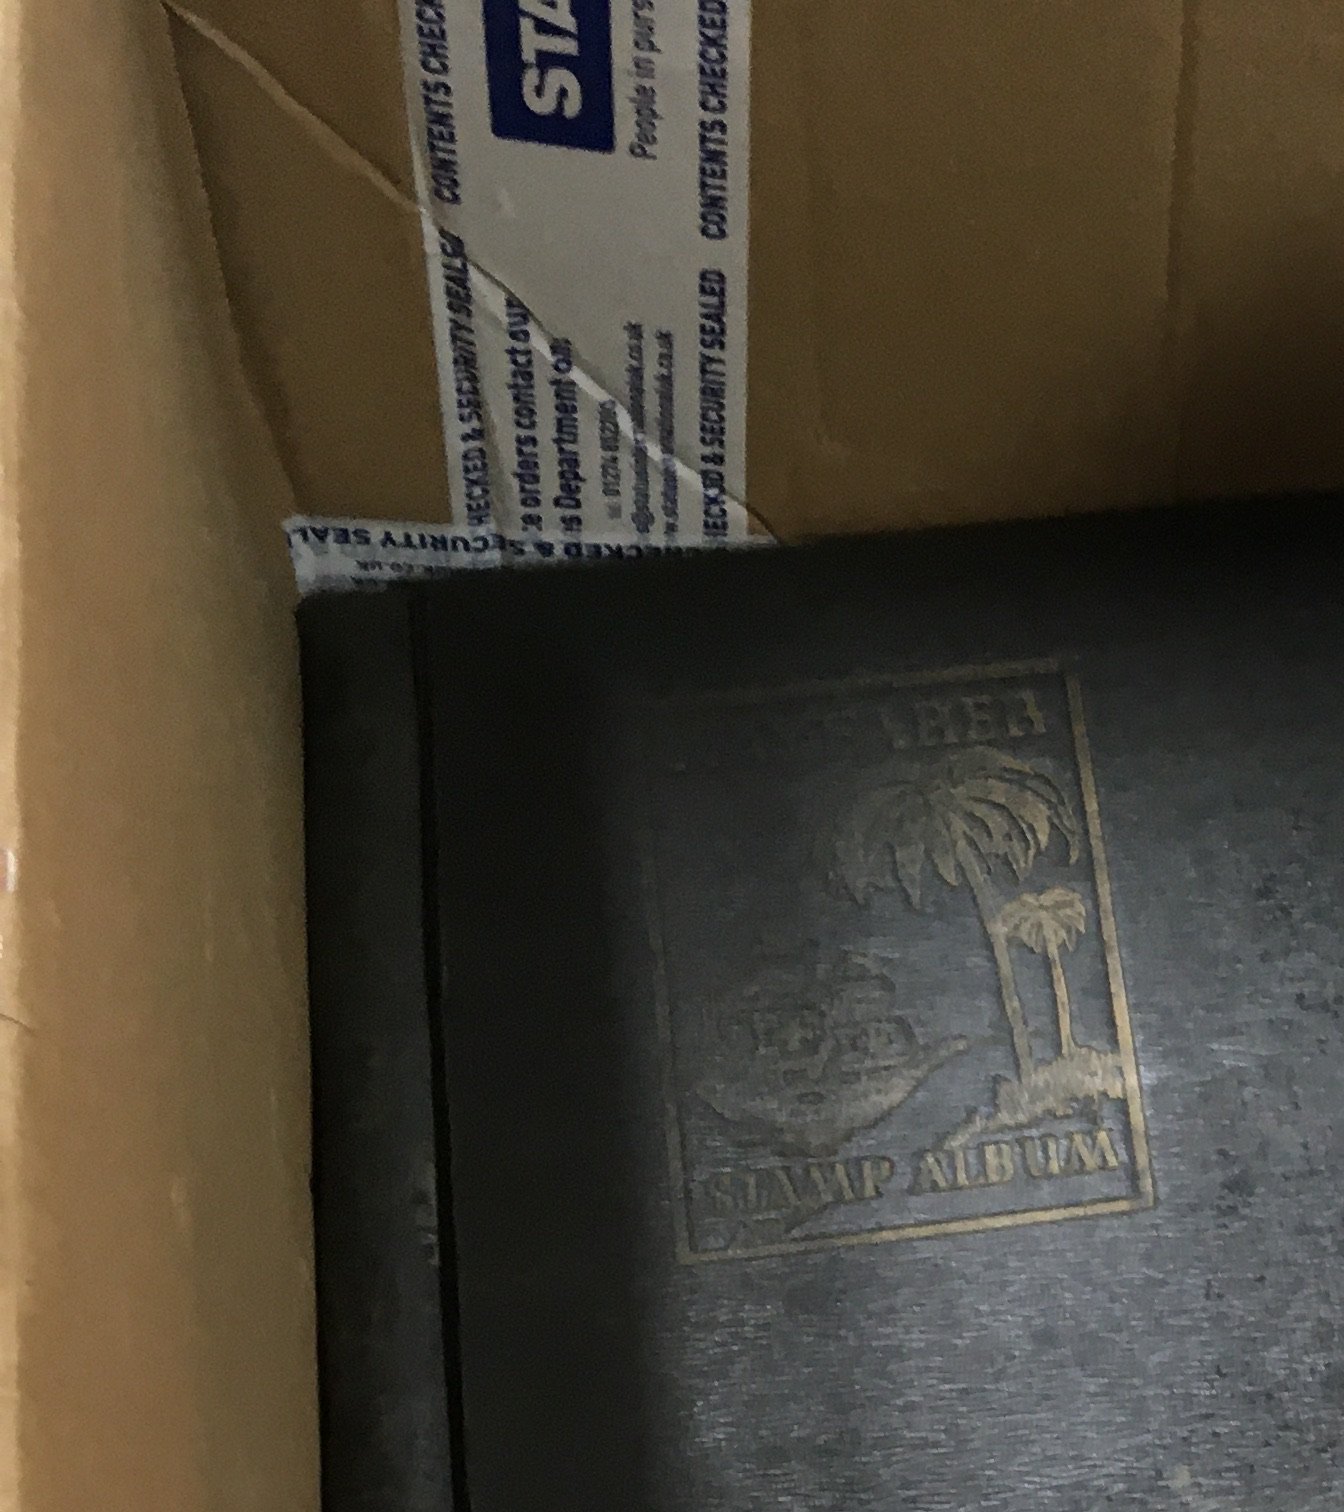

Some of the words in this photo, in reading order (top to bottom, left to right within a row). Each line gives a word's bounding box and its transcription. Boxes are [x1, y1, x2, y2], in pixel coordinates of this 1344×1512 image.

[698, 0, 728, 115] CHECKED
[421, 78, 461, 205] CONTENTS
[626, 85, 664, 160] People
[698, 117, 729, 241] CONTENTS
[698, 267, 728, 351] SEALED
[448, 317, 482, 425] SECURITY
[505, 344, 538, 432] contact
[699, 352, 727, 450] SECURITY
[460, 424, 488, 446] &
[511, 433, 542, 509] orders
[550, 376, 586, 511] Department
[700, 452, 727, 469] &
[381, 529, 524, 557] SECURITY
[708, 1155, 896, 1208] STAMP
[908, 1127, 1121, 1195] ALBUM
